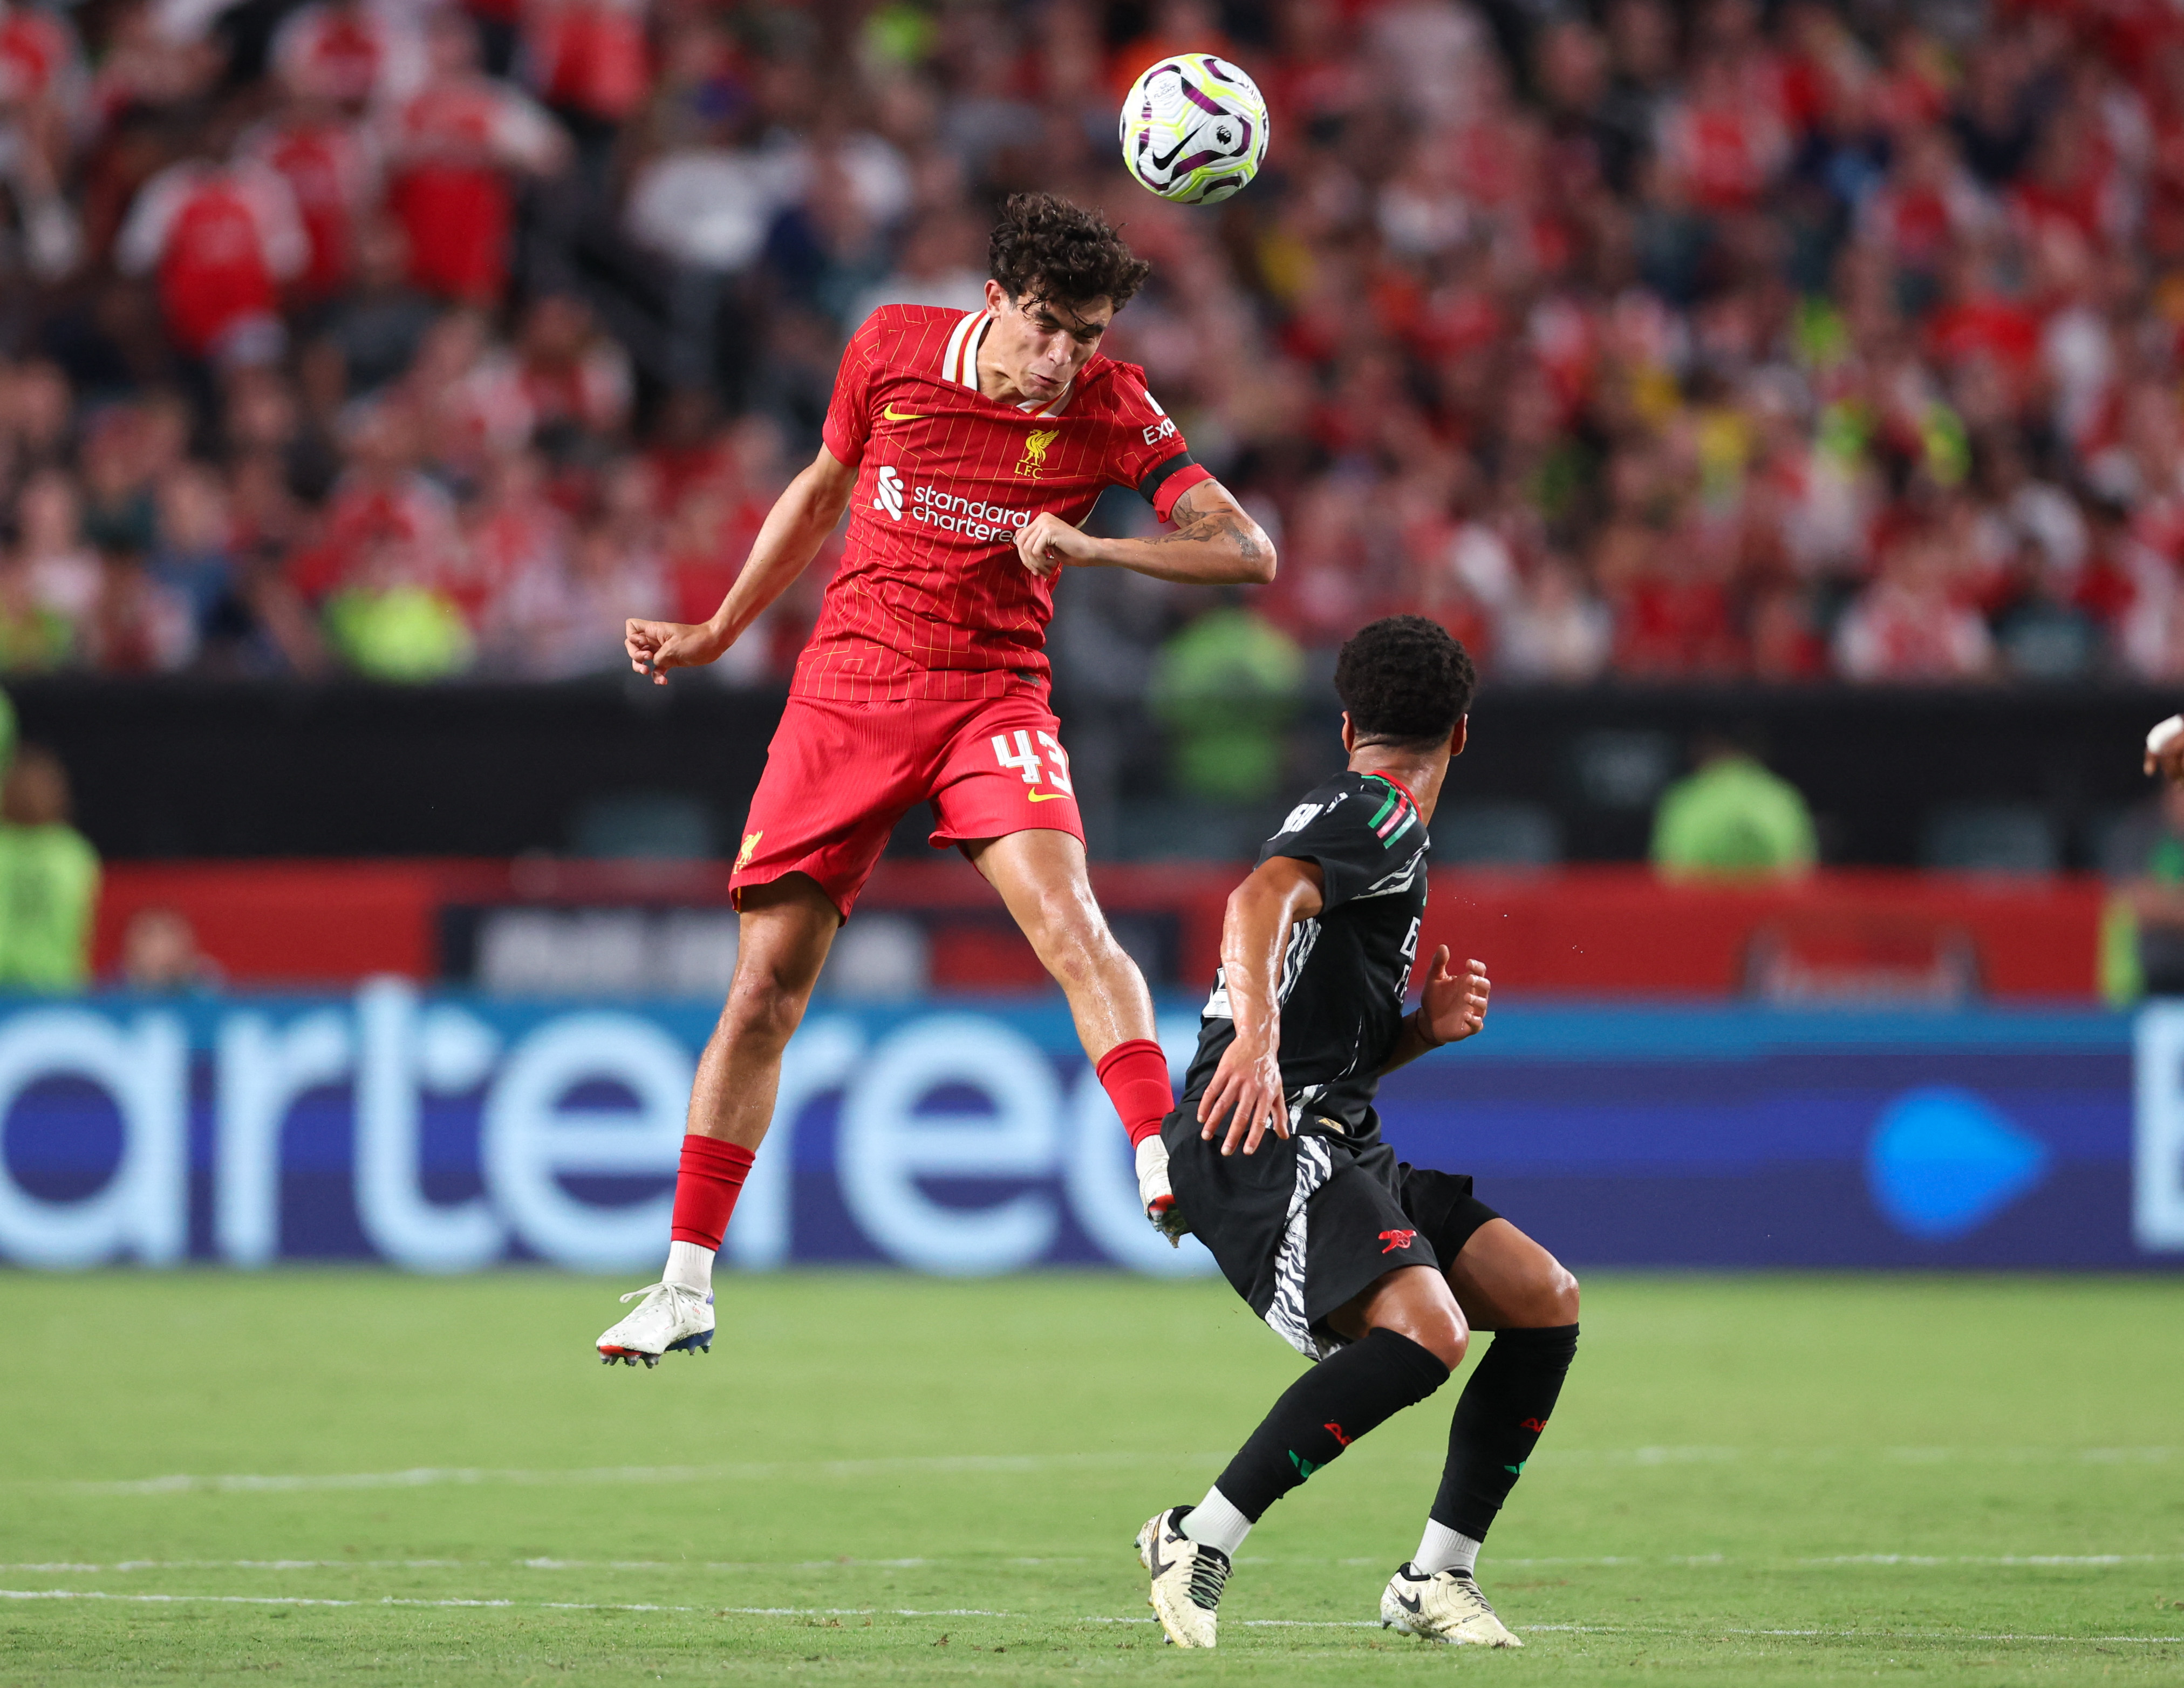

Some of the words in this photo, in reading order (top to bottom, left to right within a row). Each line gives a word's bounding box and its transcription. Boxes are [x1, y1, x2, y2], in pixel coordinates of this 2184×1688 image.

[1143, 417, 1177, 445] Exp
[912, 506, 1018, 545] chartere
[913, 485, 1031, 528] standard
[991, 730, 1072, 797] 43
